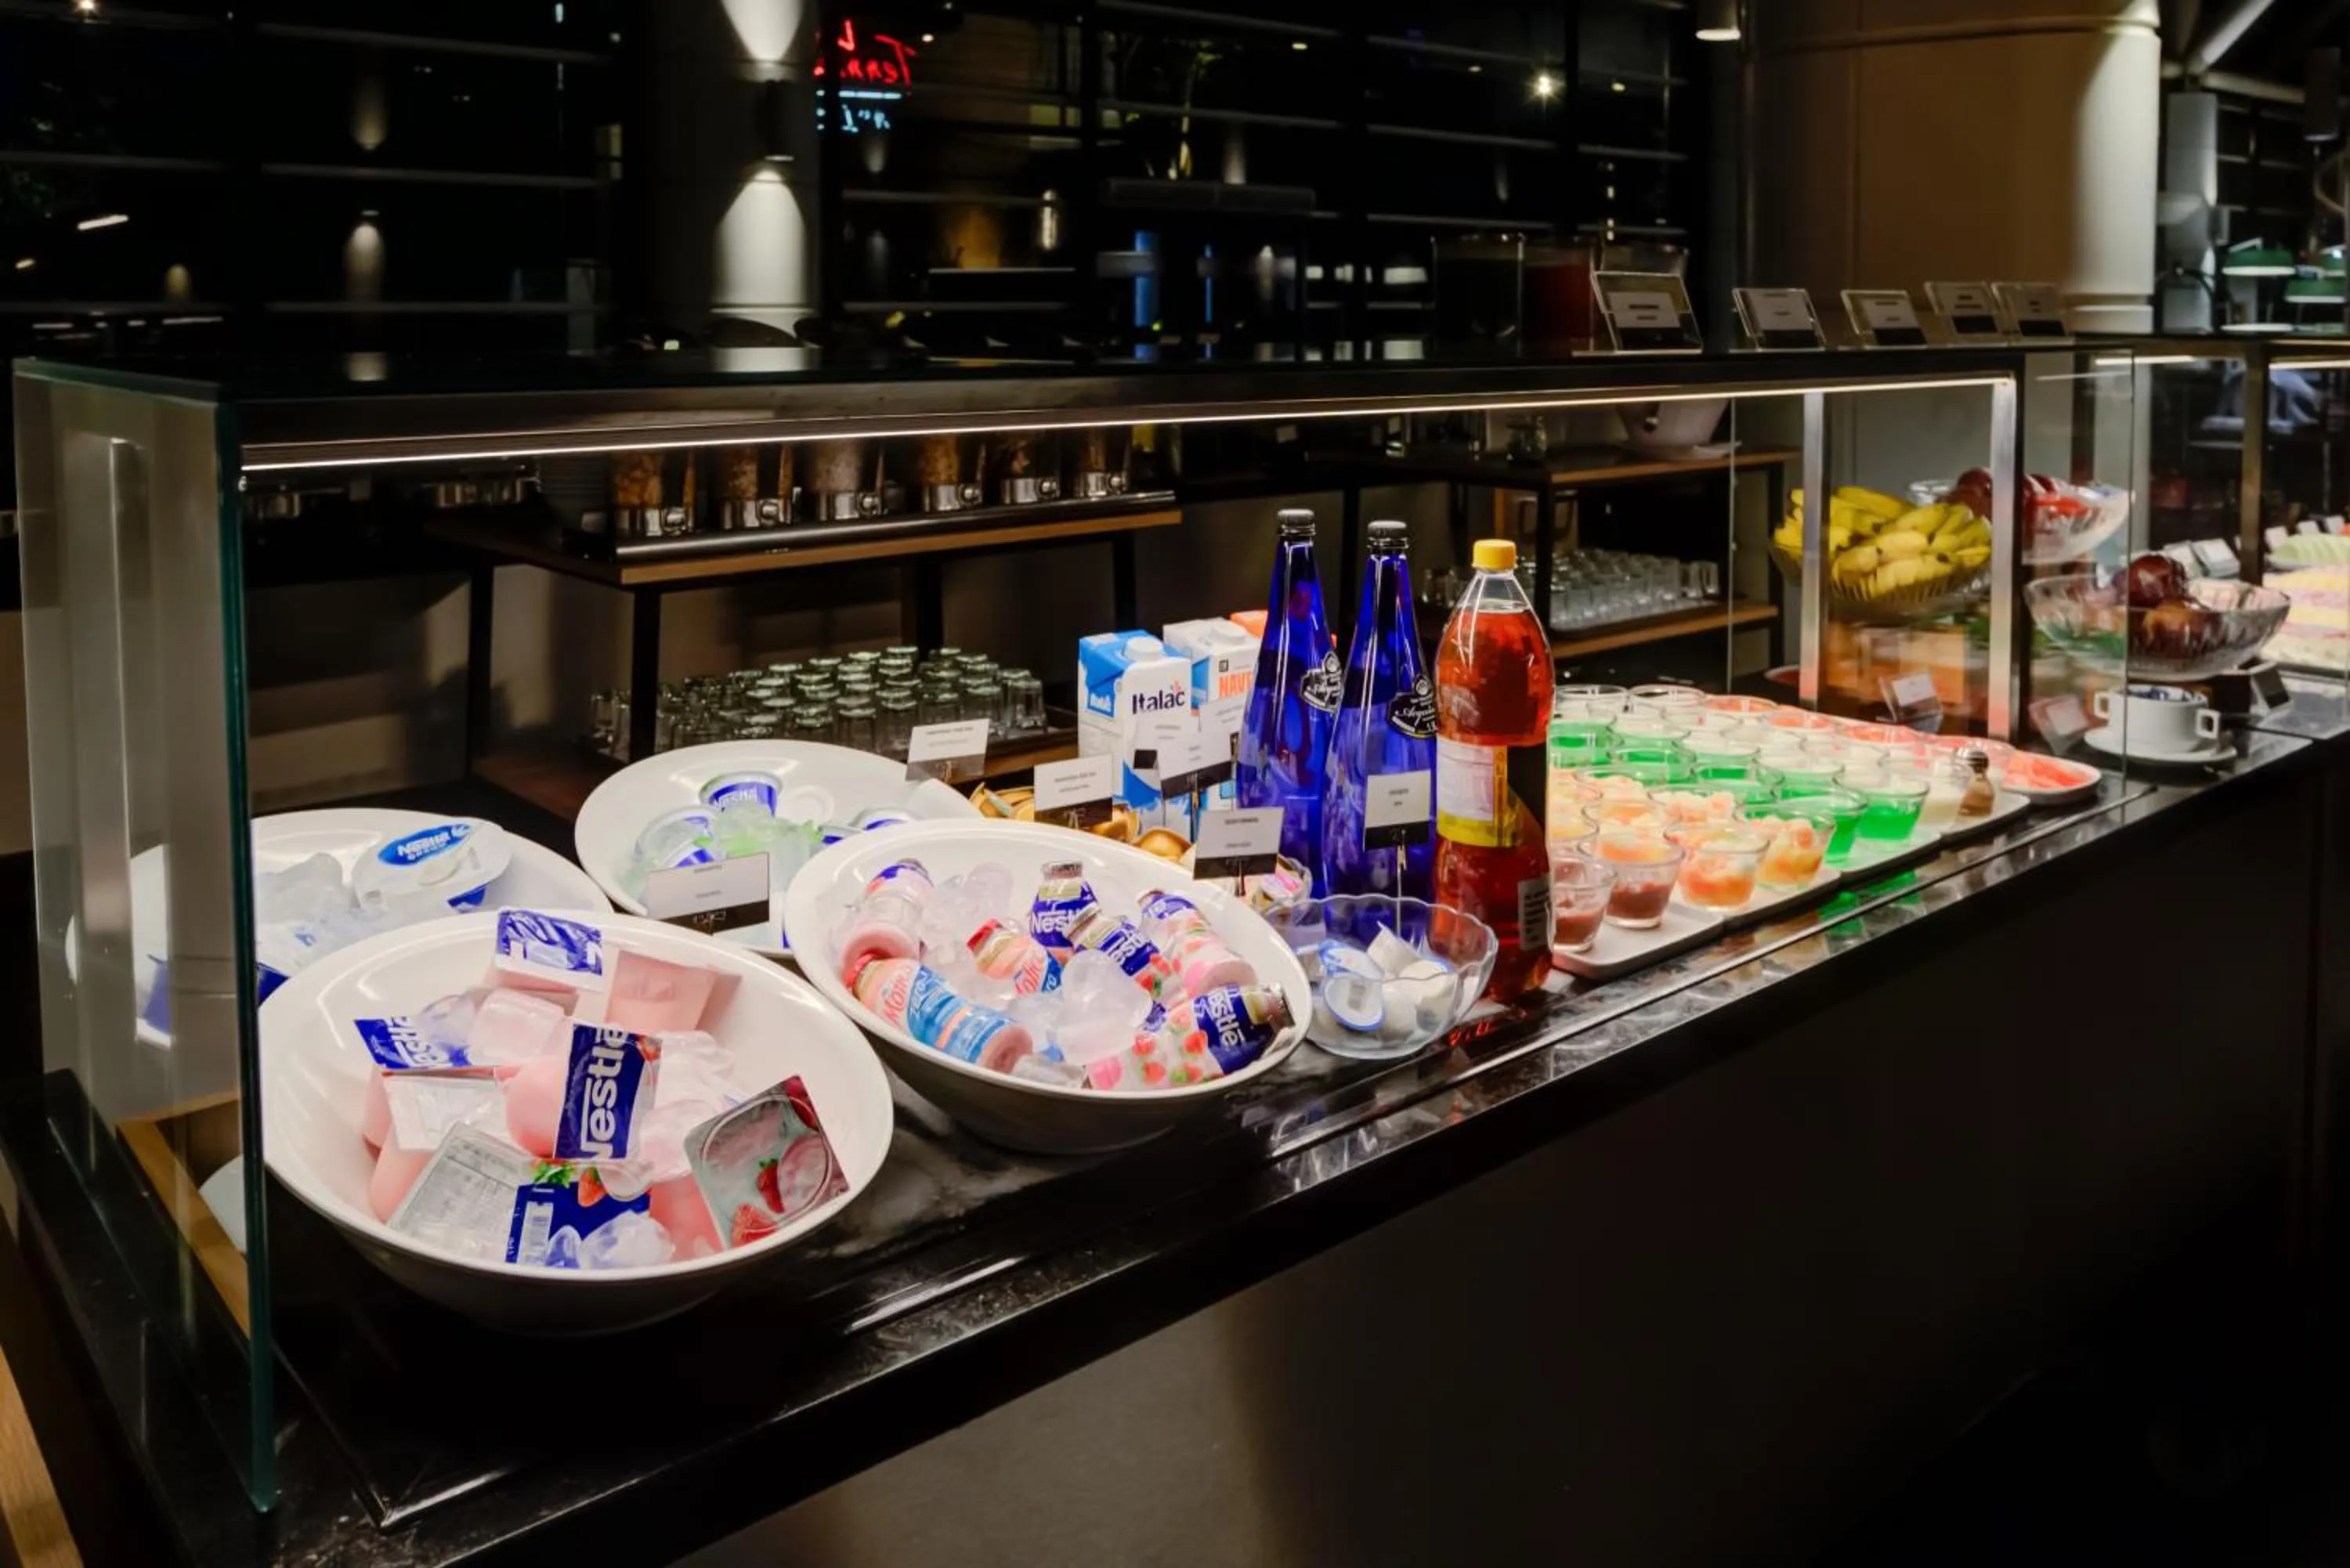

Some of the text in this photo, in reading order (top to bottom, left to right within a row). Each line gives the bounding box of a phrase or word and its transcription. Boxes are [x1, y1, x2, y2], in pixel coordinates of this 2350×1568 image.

[1132, 689, 1186, 714] Italac
[1030, 909, 1085, 935] Nest
[1208, 988, 1246, 1048] estlé
